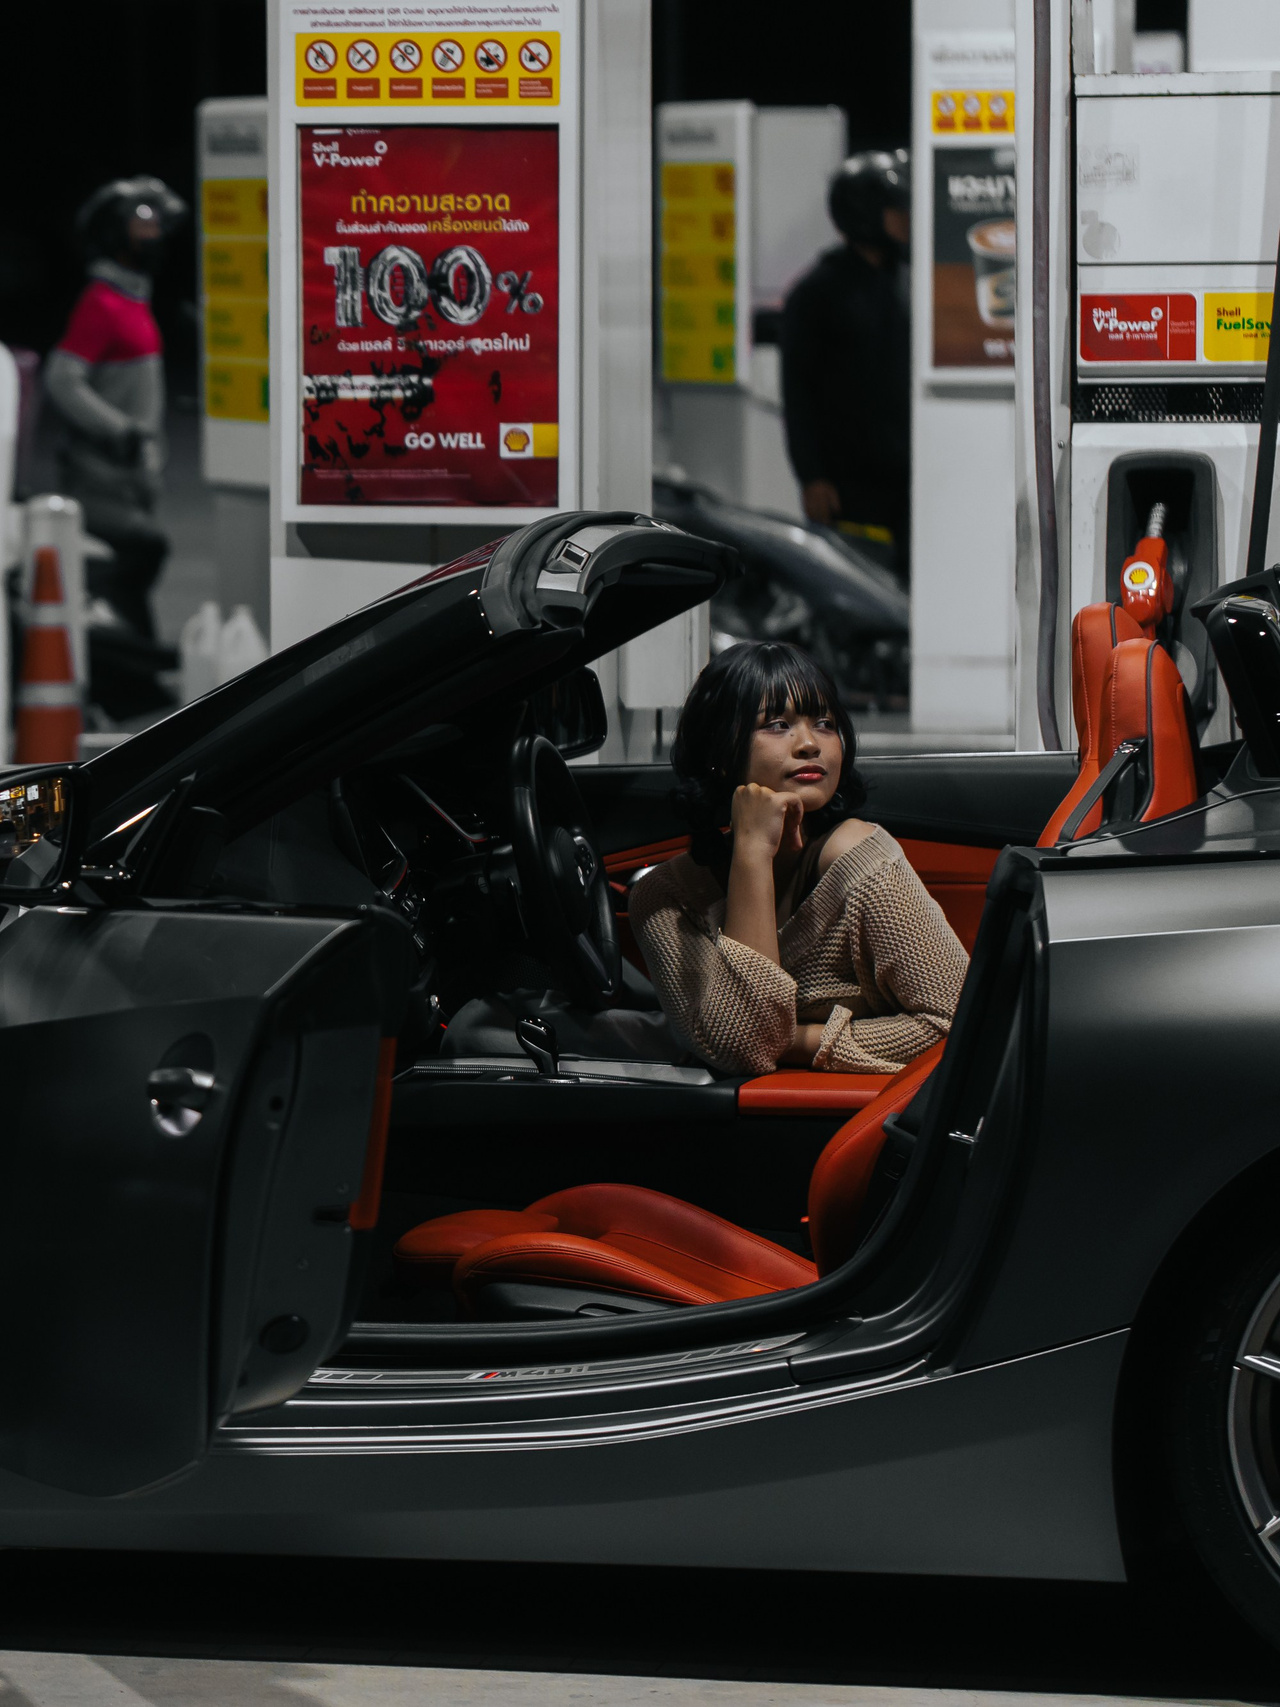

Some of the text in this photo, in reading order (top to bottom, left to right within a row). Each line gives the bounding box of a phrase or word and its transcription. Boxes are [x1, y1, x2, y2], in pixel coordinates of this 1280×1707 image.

[312, 141, 339, 153] Shell
[313, 153, 383, 167] V-Power
[351, 188, 510, 213] ทำความสะอาด
[324, 245, 544, 328] 100%
[1093, 308, 1118, 319] Shell
[1216, 307, 1241, 317] Shell
[1093, 318, 1158, 333] V-Power
[1216, 317, 1271, 331] FuelSav
[404, 432, 486, 449] GO WELL
